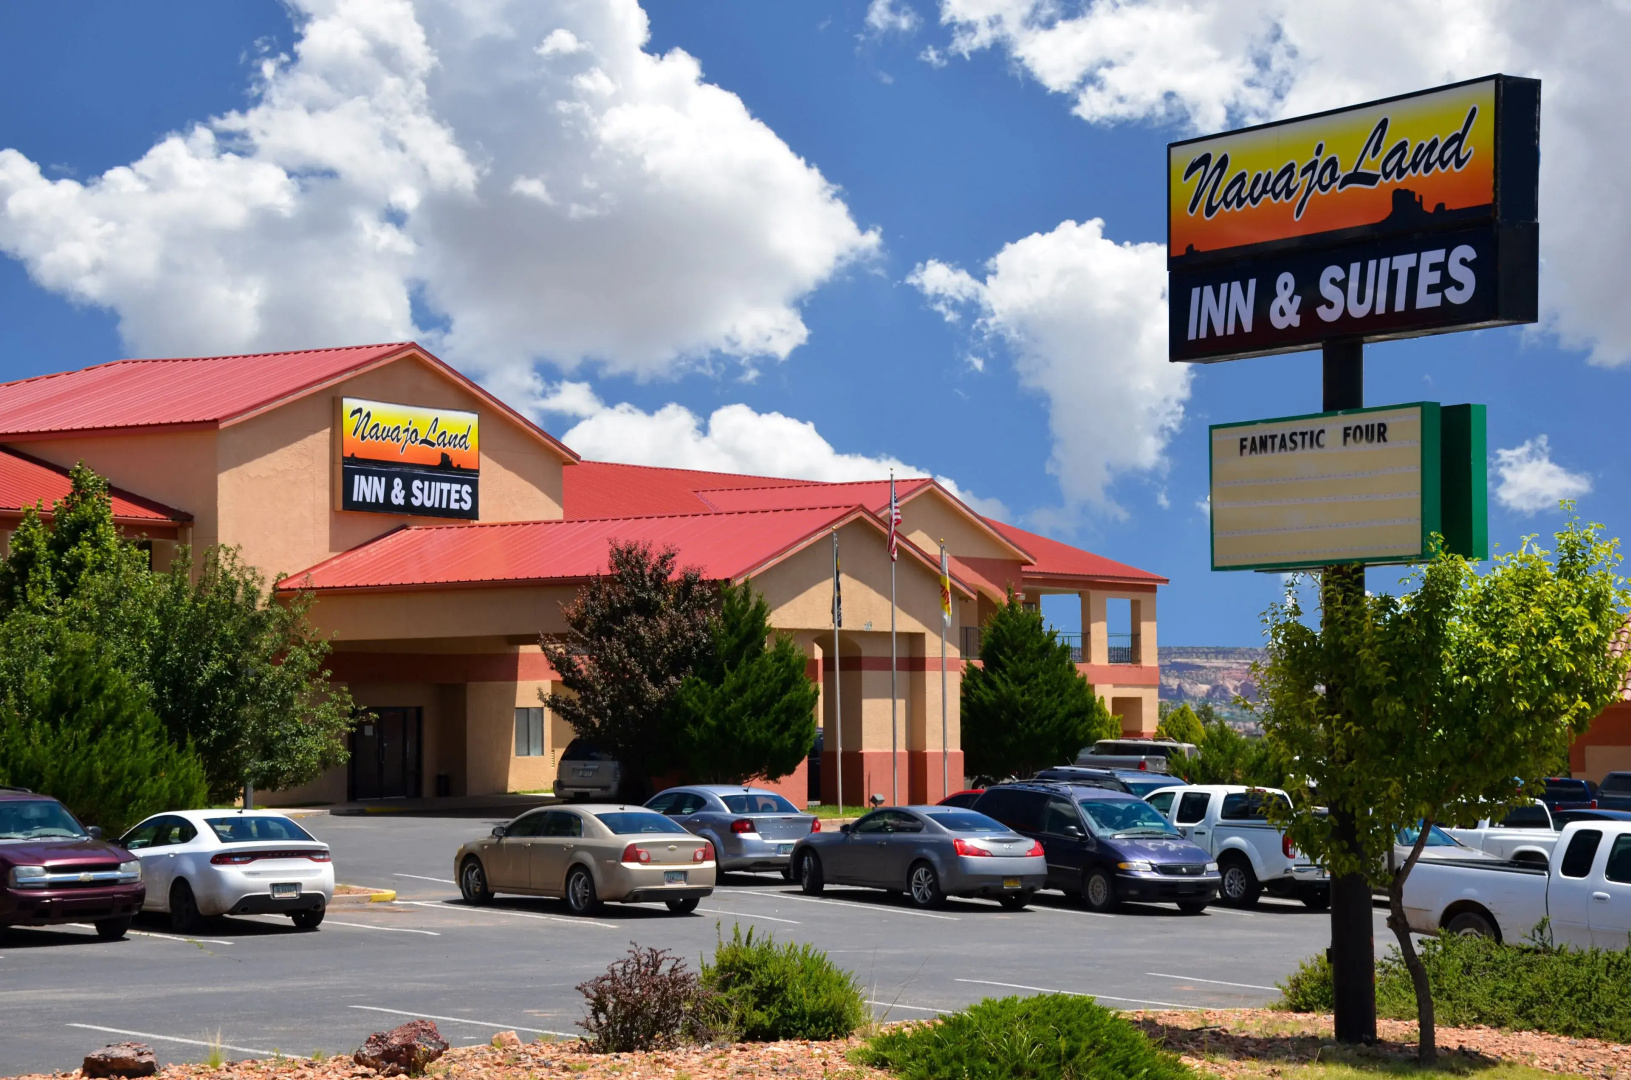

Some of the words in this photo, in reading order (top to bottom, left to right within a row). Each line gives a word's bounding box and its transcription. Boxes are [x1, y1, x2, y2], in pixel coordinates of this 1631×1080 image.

[1187, 278, 1257, 341] INN
[1269, 272, 1302, 329] &
[1316, 245, 1477, 322] SUITES
[1239, 429, 1325, 457] FANTASTIC
[1342, 422, 1388, 446] FOUR
[352, 475, 385, 503] INN
[391, 478, 405, 506] &
[411, 480, 472, 511] SUITES
